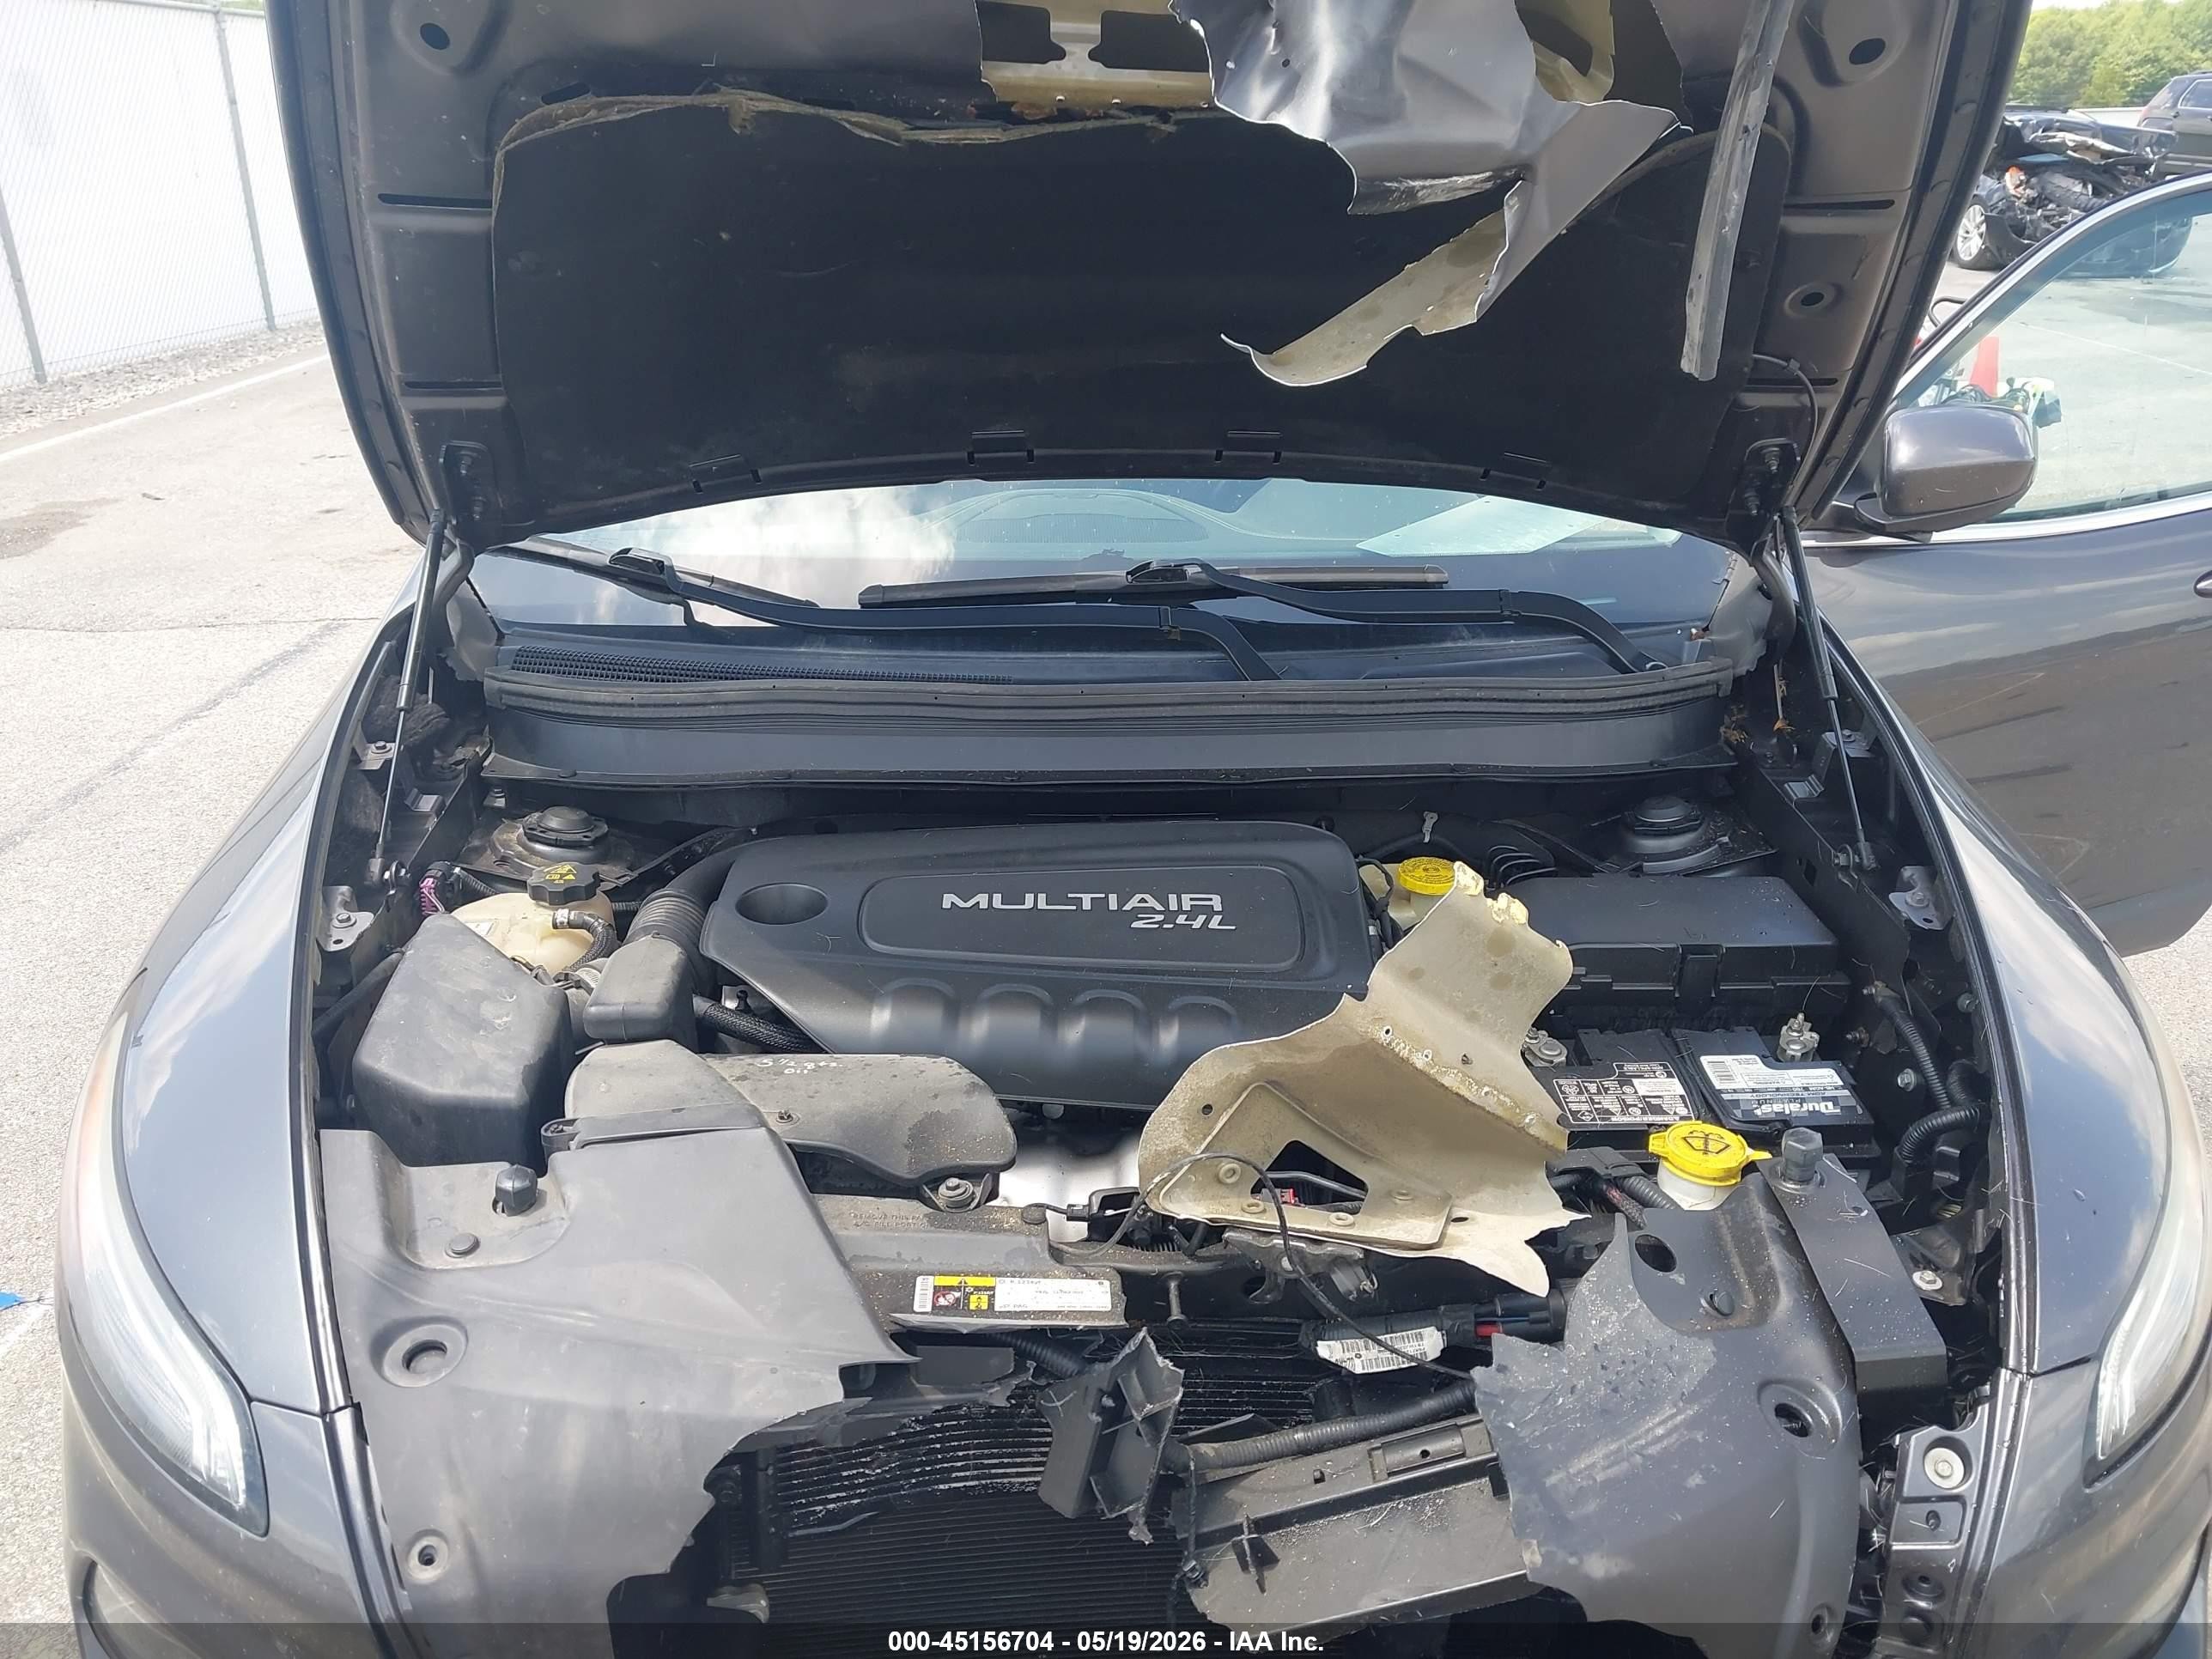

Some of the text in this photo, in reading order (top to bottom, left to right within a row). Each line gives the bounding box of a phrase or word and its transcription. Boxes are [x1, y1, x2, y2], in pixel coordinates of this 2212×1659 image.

[941, 893, 1223, 911] MULTIAIR
[1130, 914, 1237, 930] 2.4L
[1753, 1100, 1841, 1116] Duralast
